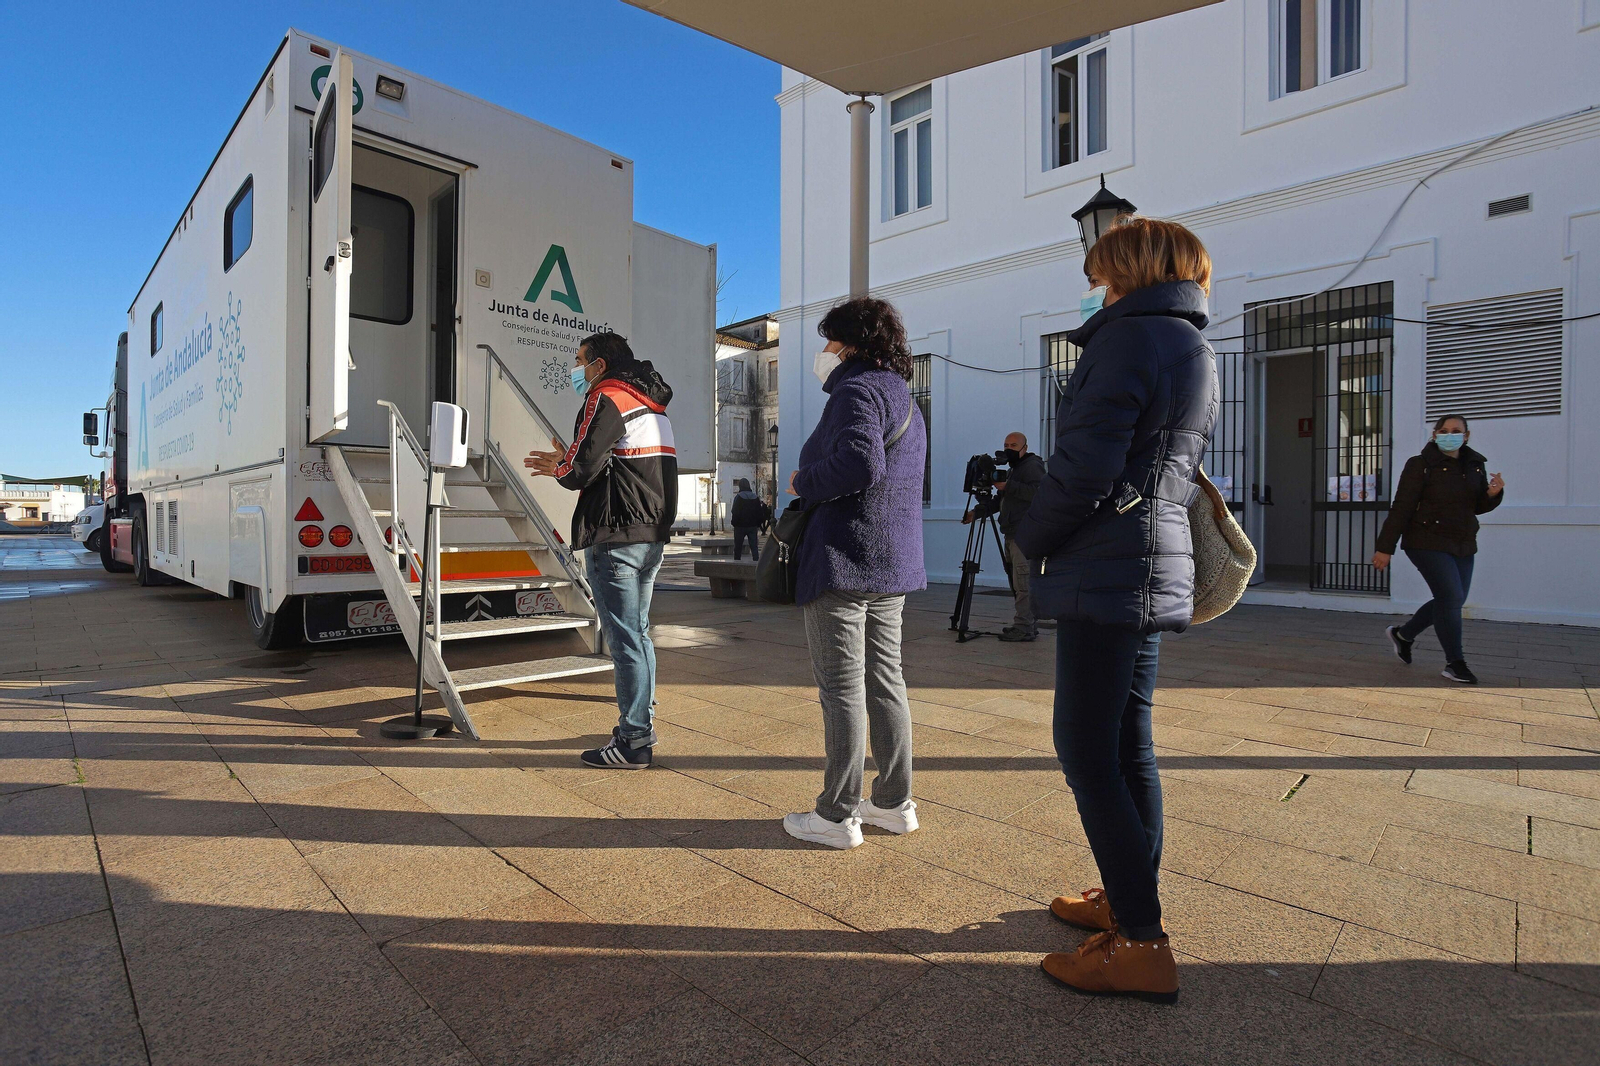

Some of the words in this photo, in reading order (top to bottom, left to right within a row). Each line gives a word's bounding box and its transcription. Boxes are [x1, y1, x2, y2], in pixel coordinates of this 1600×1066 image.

[488, 299, 529, 319] Junta
[532, 308, 549, 323] de
[502, 320, 539, 334] Consejería
[541, 328, 550, 336] de
[551, 330, 571, 340] Salud
[150, 369, 164, 401] Junta
[165, 355, 173, 388] de
[174, 311, 212, 381] Andalucía
[517, 337, 558, 350] RESPUESTA
[560, 345, 579, 355] COVID
[328, 629, 347, 637] 957
